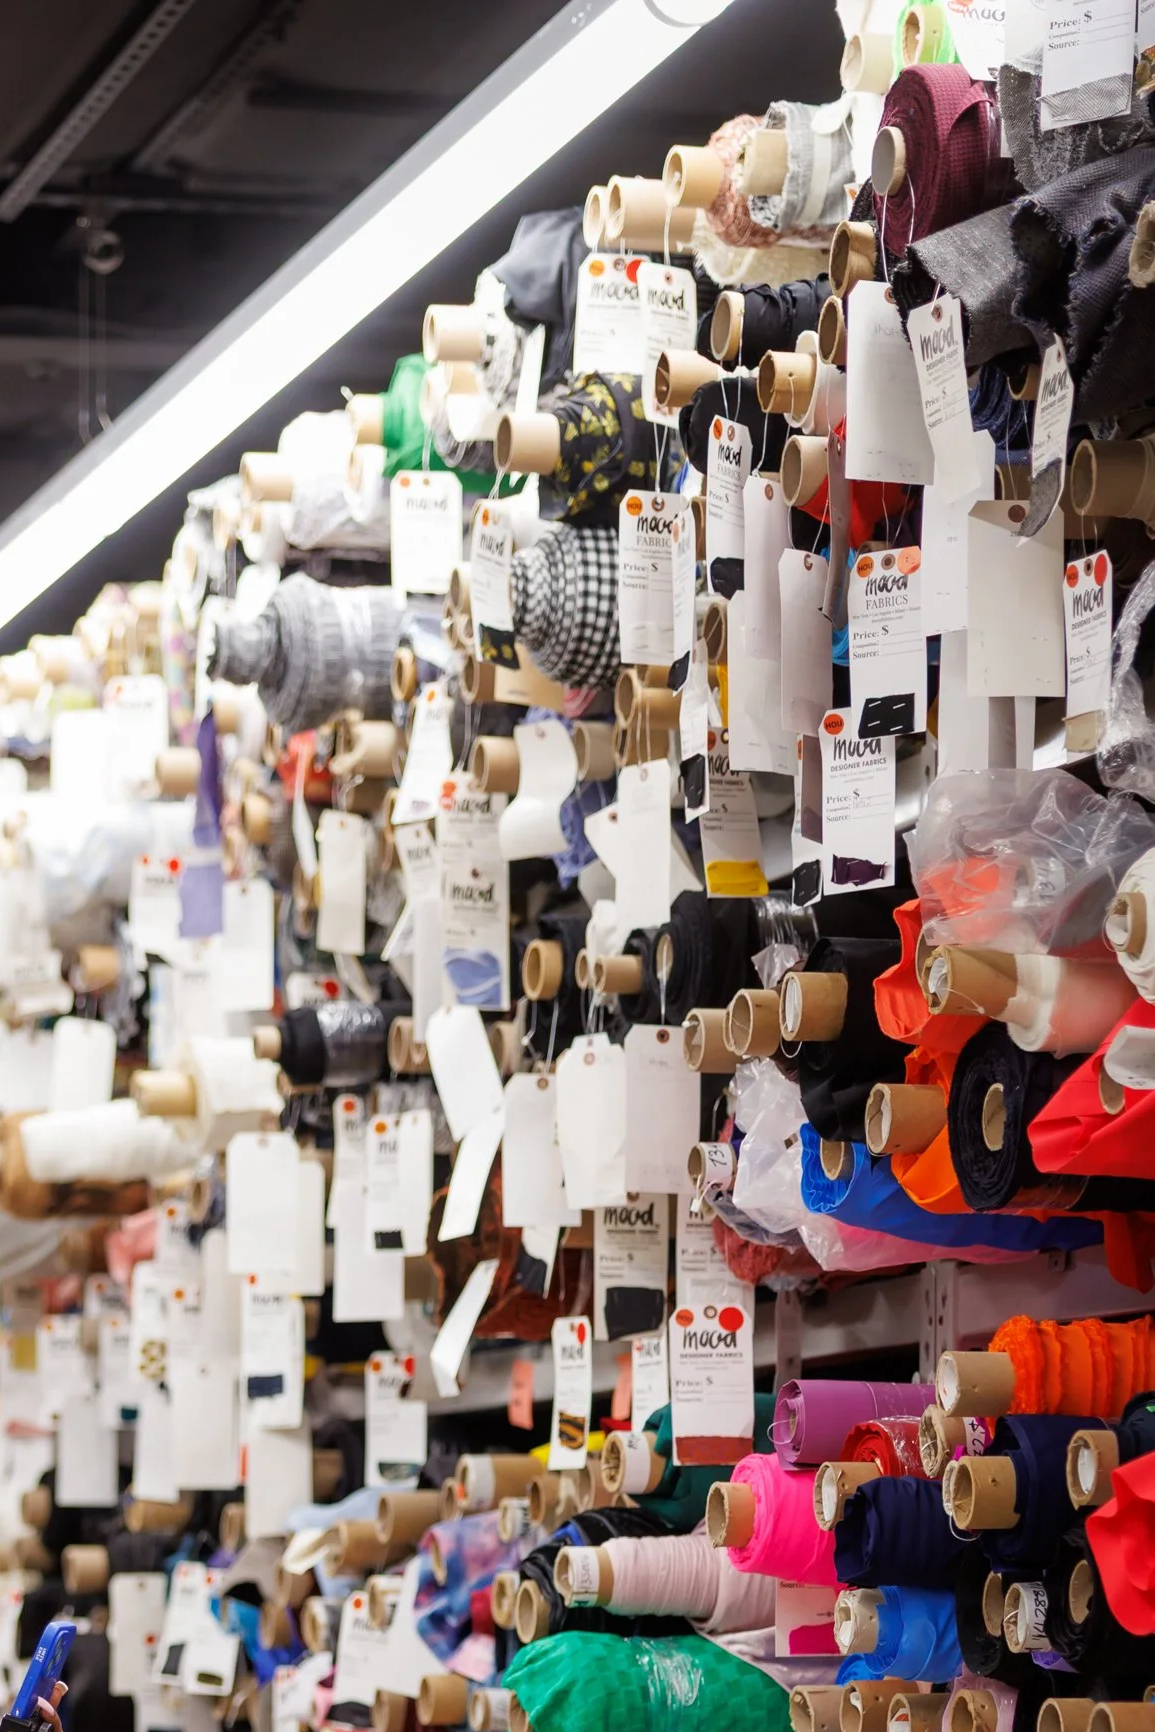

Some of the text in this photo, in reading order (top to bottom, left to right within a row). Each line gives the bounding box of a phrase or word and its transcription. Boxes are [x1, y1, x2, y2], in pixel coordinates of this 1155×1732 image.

[1049, 10, 1093, 30] Price: $
[1048, 39, 1080, 51] Source:
[636, 536, 672, 548] FABRIC
[651, 563, 659, 573] $
[857, 562, 874, 572] HOU
[865, 594, 909, 610] FABRICS
[853, 624, 890, 641] Price: $
[852, 649, 880, 660] Source:
[825, 719, 844, 730] HOU
[830, 757, 887, 773] DESIGNER FABRICS
[826, 794, 852, 805] Price:
[853, 787, 861, 800] $
[603, 1202, 655, 1227] mood
[683, 1327, 738, 1351] mood
